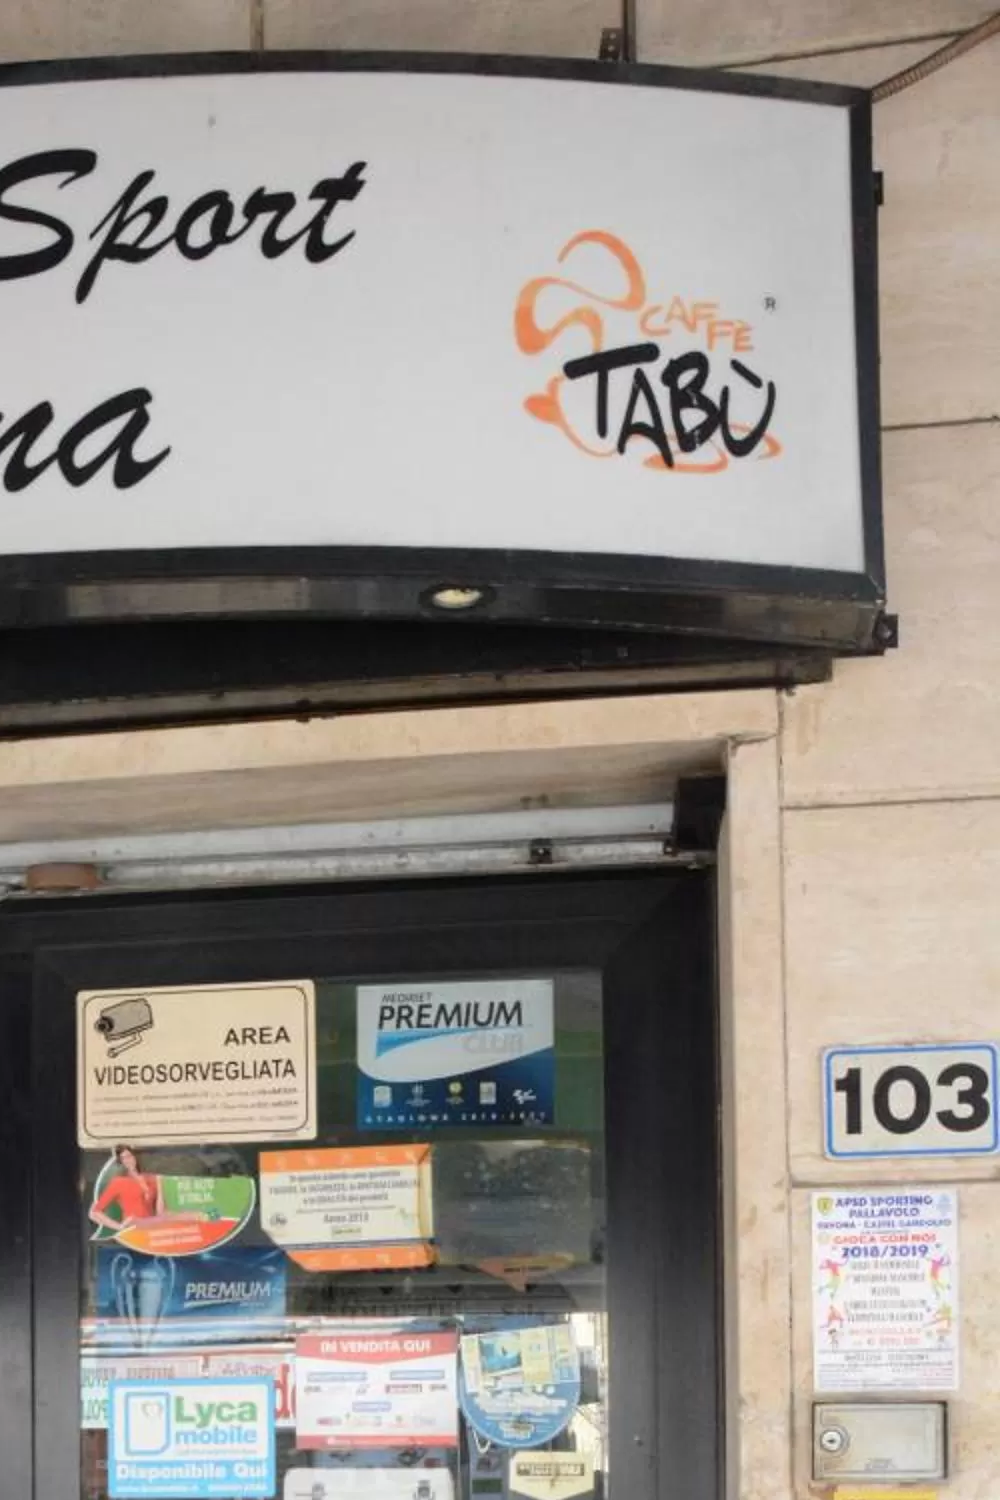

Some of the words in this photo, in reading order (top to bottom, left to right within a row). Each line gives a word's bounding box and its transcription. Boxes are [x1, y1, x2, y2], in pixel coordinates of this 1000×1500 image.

[563, 341, 777, 470] TABÙ
[378, 999, 524, 1030] PREMIUM
[223, 1026, 292, 1046] AREA
[94, 1058, 297, 1086] VIDEOSORVEGLIATA
[834, 1062, 991, 1135] 103
[870, 1195, 934, 1207] SPORTING
[848, 1207, 920, 1219] PALLAVOLO
[841, 1244, 930, 1259] 2018/2019
[184, 1280, 272, 1300] PREMIUM
[320, 1340, 337, 1354] IN
[339, 1339, 401, 1353] VENDITA
[403, 1339, 431, 1352] QUI
[173, 1395, 259, 1428] Lyca
[175, 1425, 258, 1445] mobile
[116, 1463, 227, 1484] Disponibile
[233, 1460, 267, 1479] Qui
